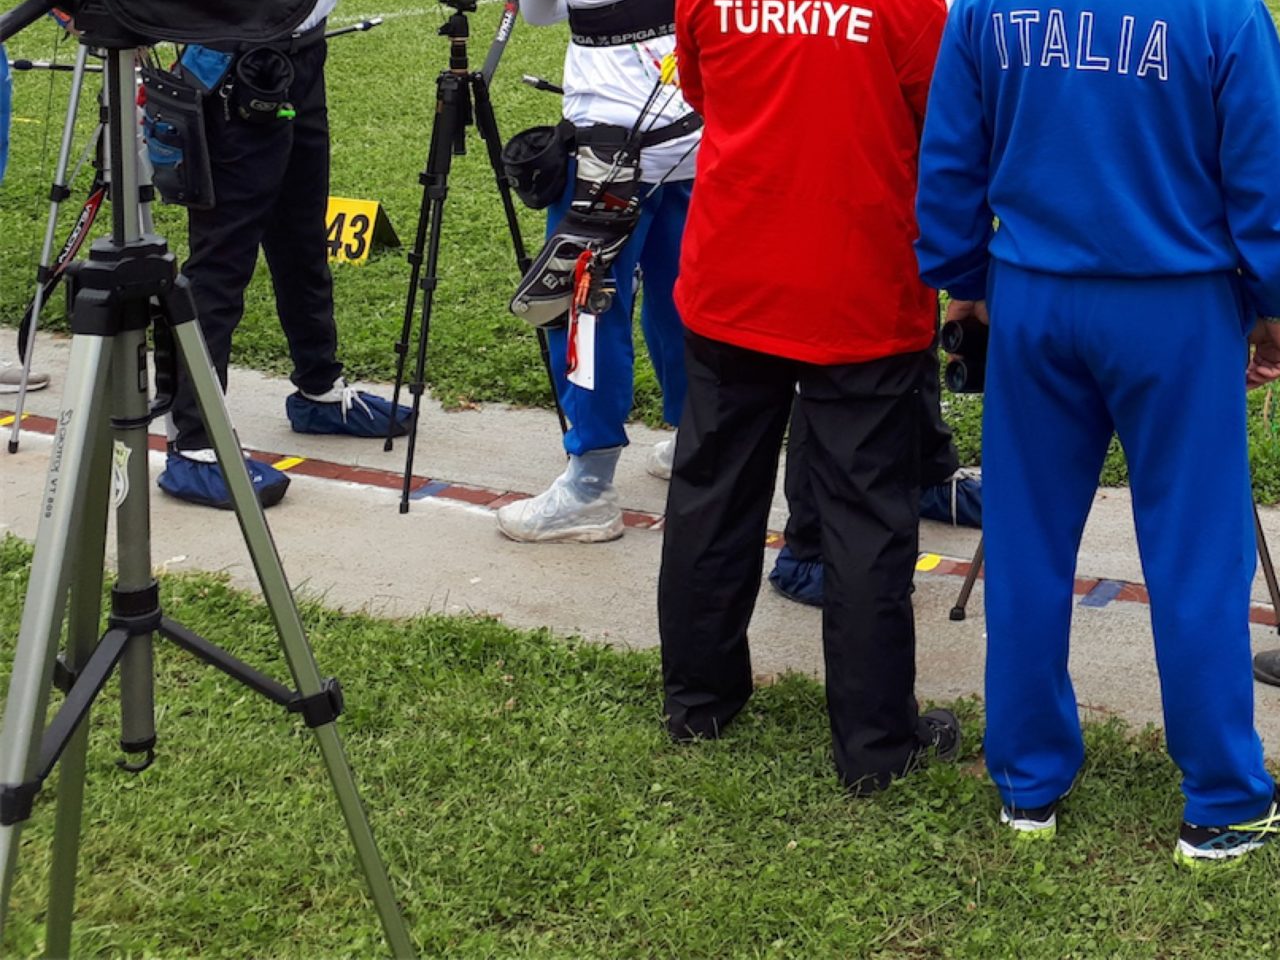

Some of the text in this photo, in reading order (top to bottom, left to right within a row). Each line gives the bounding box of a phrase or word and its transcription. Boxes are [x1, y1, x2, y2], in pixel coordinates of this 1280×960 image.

[611, 28, 656, 44] SPIGA
[992, 9, 1168, 81] ITALIA
[326, 213, 369, 260] 43
